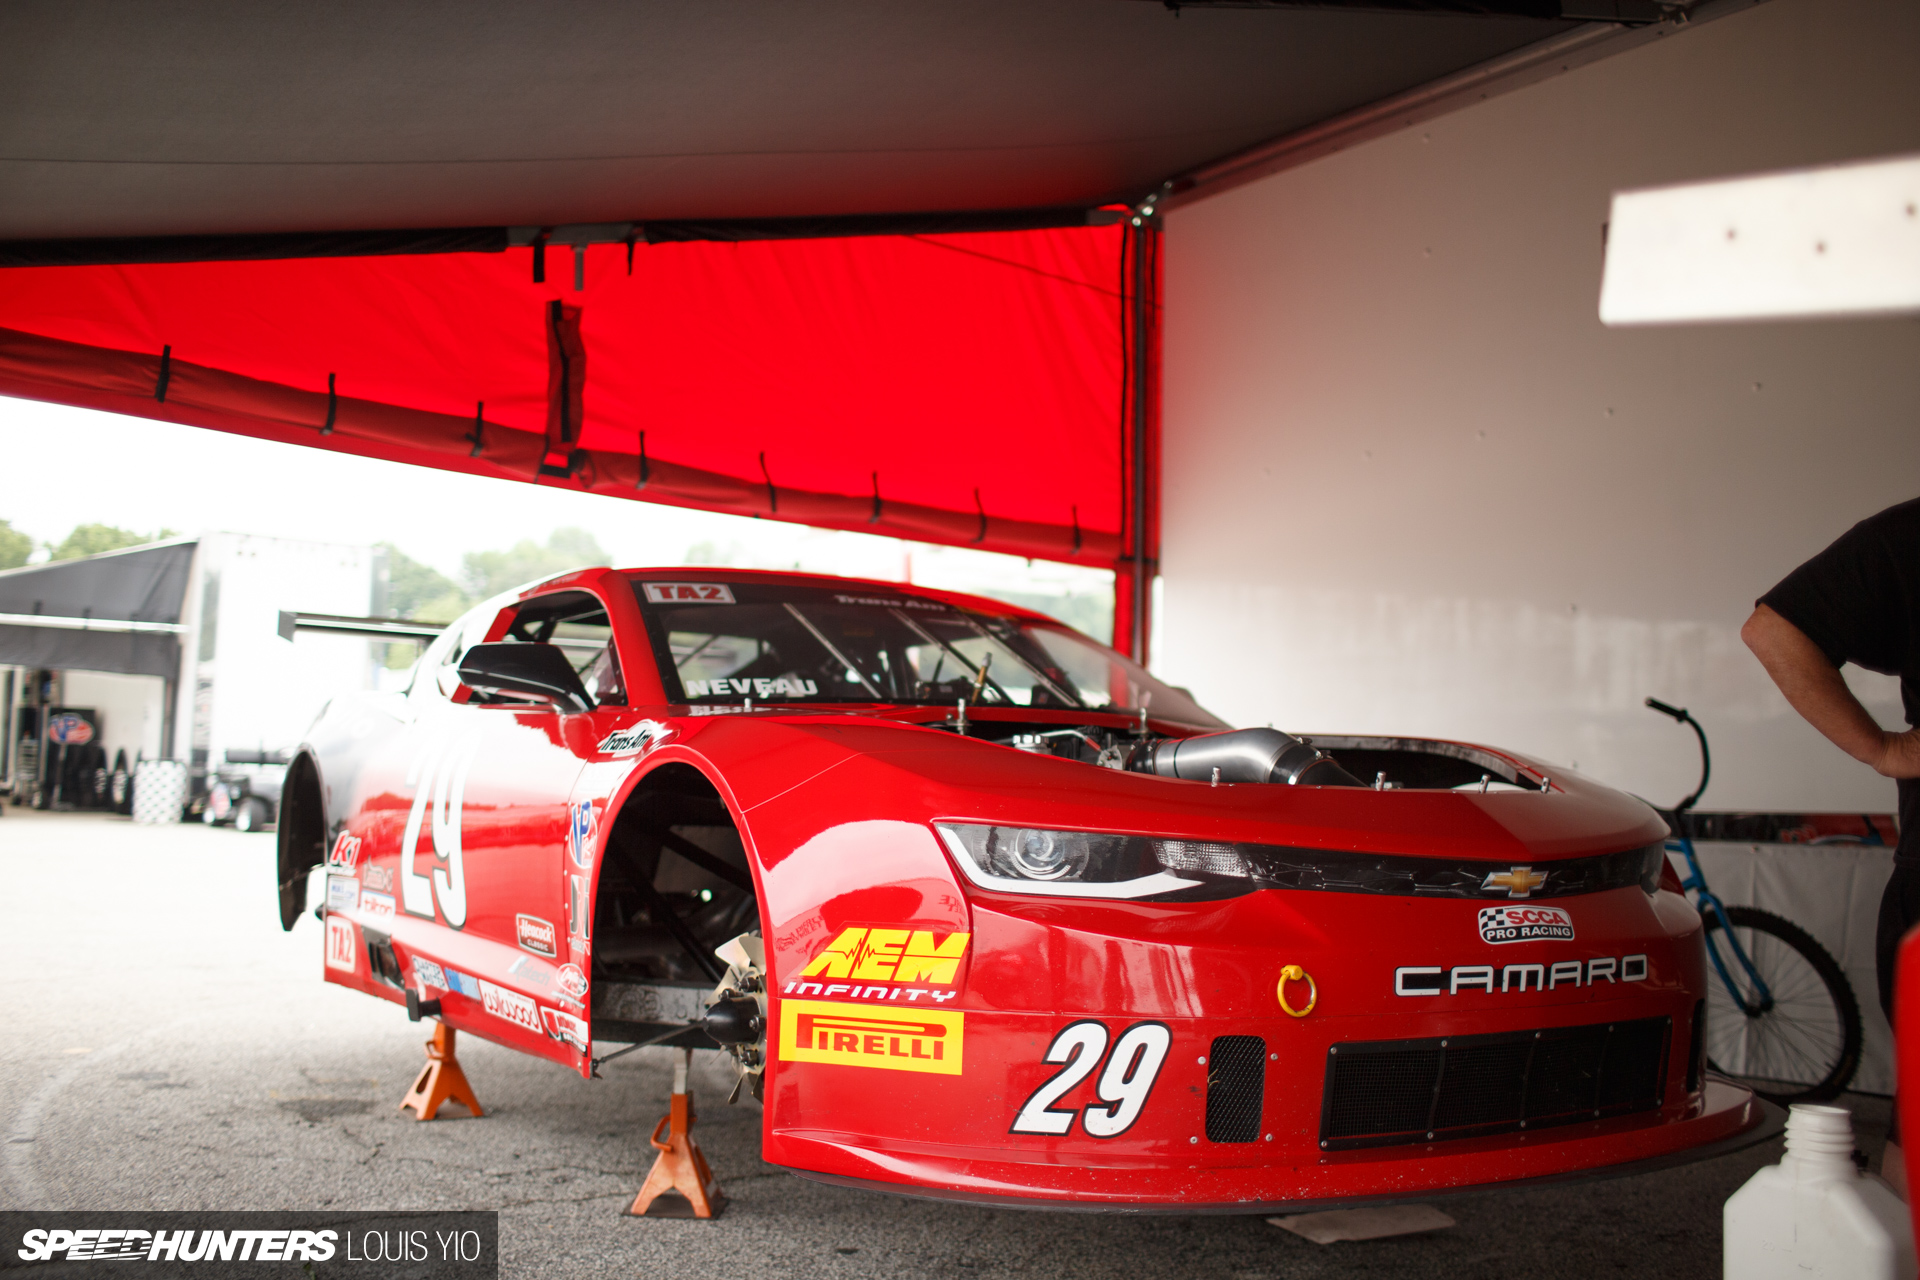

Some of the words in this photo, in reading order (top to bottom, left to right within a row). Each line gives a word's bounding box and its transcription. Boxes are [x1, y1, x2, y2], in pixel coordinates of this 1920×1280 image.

[652, 585, 725, 600] TA2
[686, 678, 818, 697] NEVEAU
[600, 732, 634, 751] Trans
[627, 729, 652, 750] Am
[401, 727, 482, 931] 29
[572, 799, 592, 866] VP
[330, 830, 362, 869] K1
[1486, 928, 1517, 940] PRO
[1521, 926, 1570, 938] RACING
[1505, 910, 1568, 926] SCCA
[331, 925, 352, 964] TA2
[798, 927, 971, 985] AEM
[784, 981, 956, 1003] INFINITY
[1395, 953, 1648, 996] CAMARO
[796, 1013, 947, 1061] PIRELLI
[1007, 1018, 1173, 1139] 29
